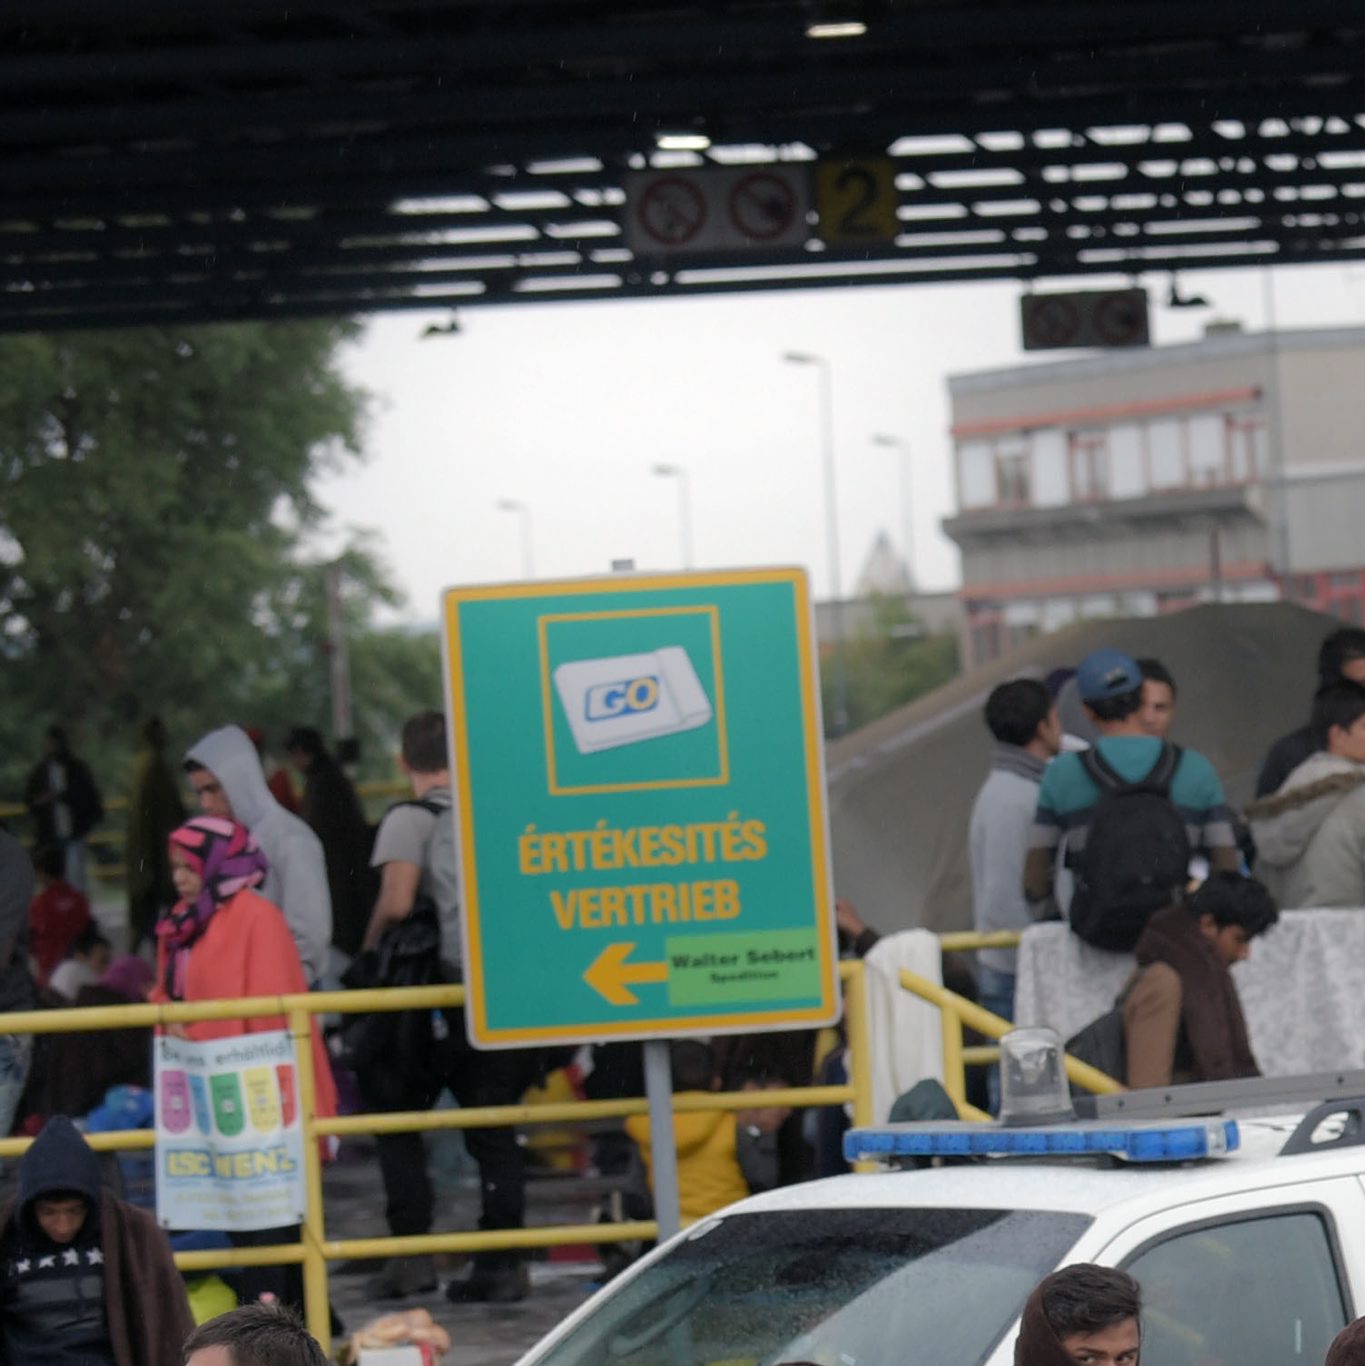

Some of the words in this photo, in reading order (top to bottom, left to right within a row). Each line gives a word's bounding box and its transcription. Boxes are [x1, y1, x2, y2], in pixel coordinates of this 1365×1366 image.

[835, 166, 878, 236] 2
[592, 676, 658, 716] GO
[549, 878, 741, 930] VERTRIEB
